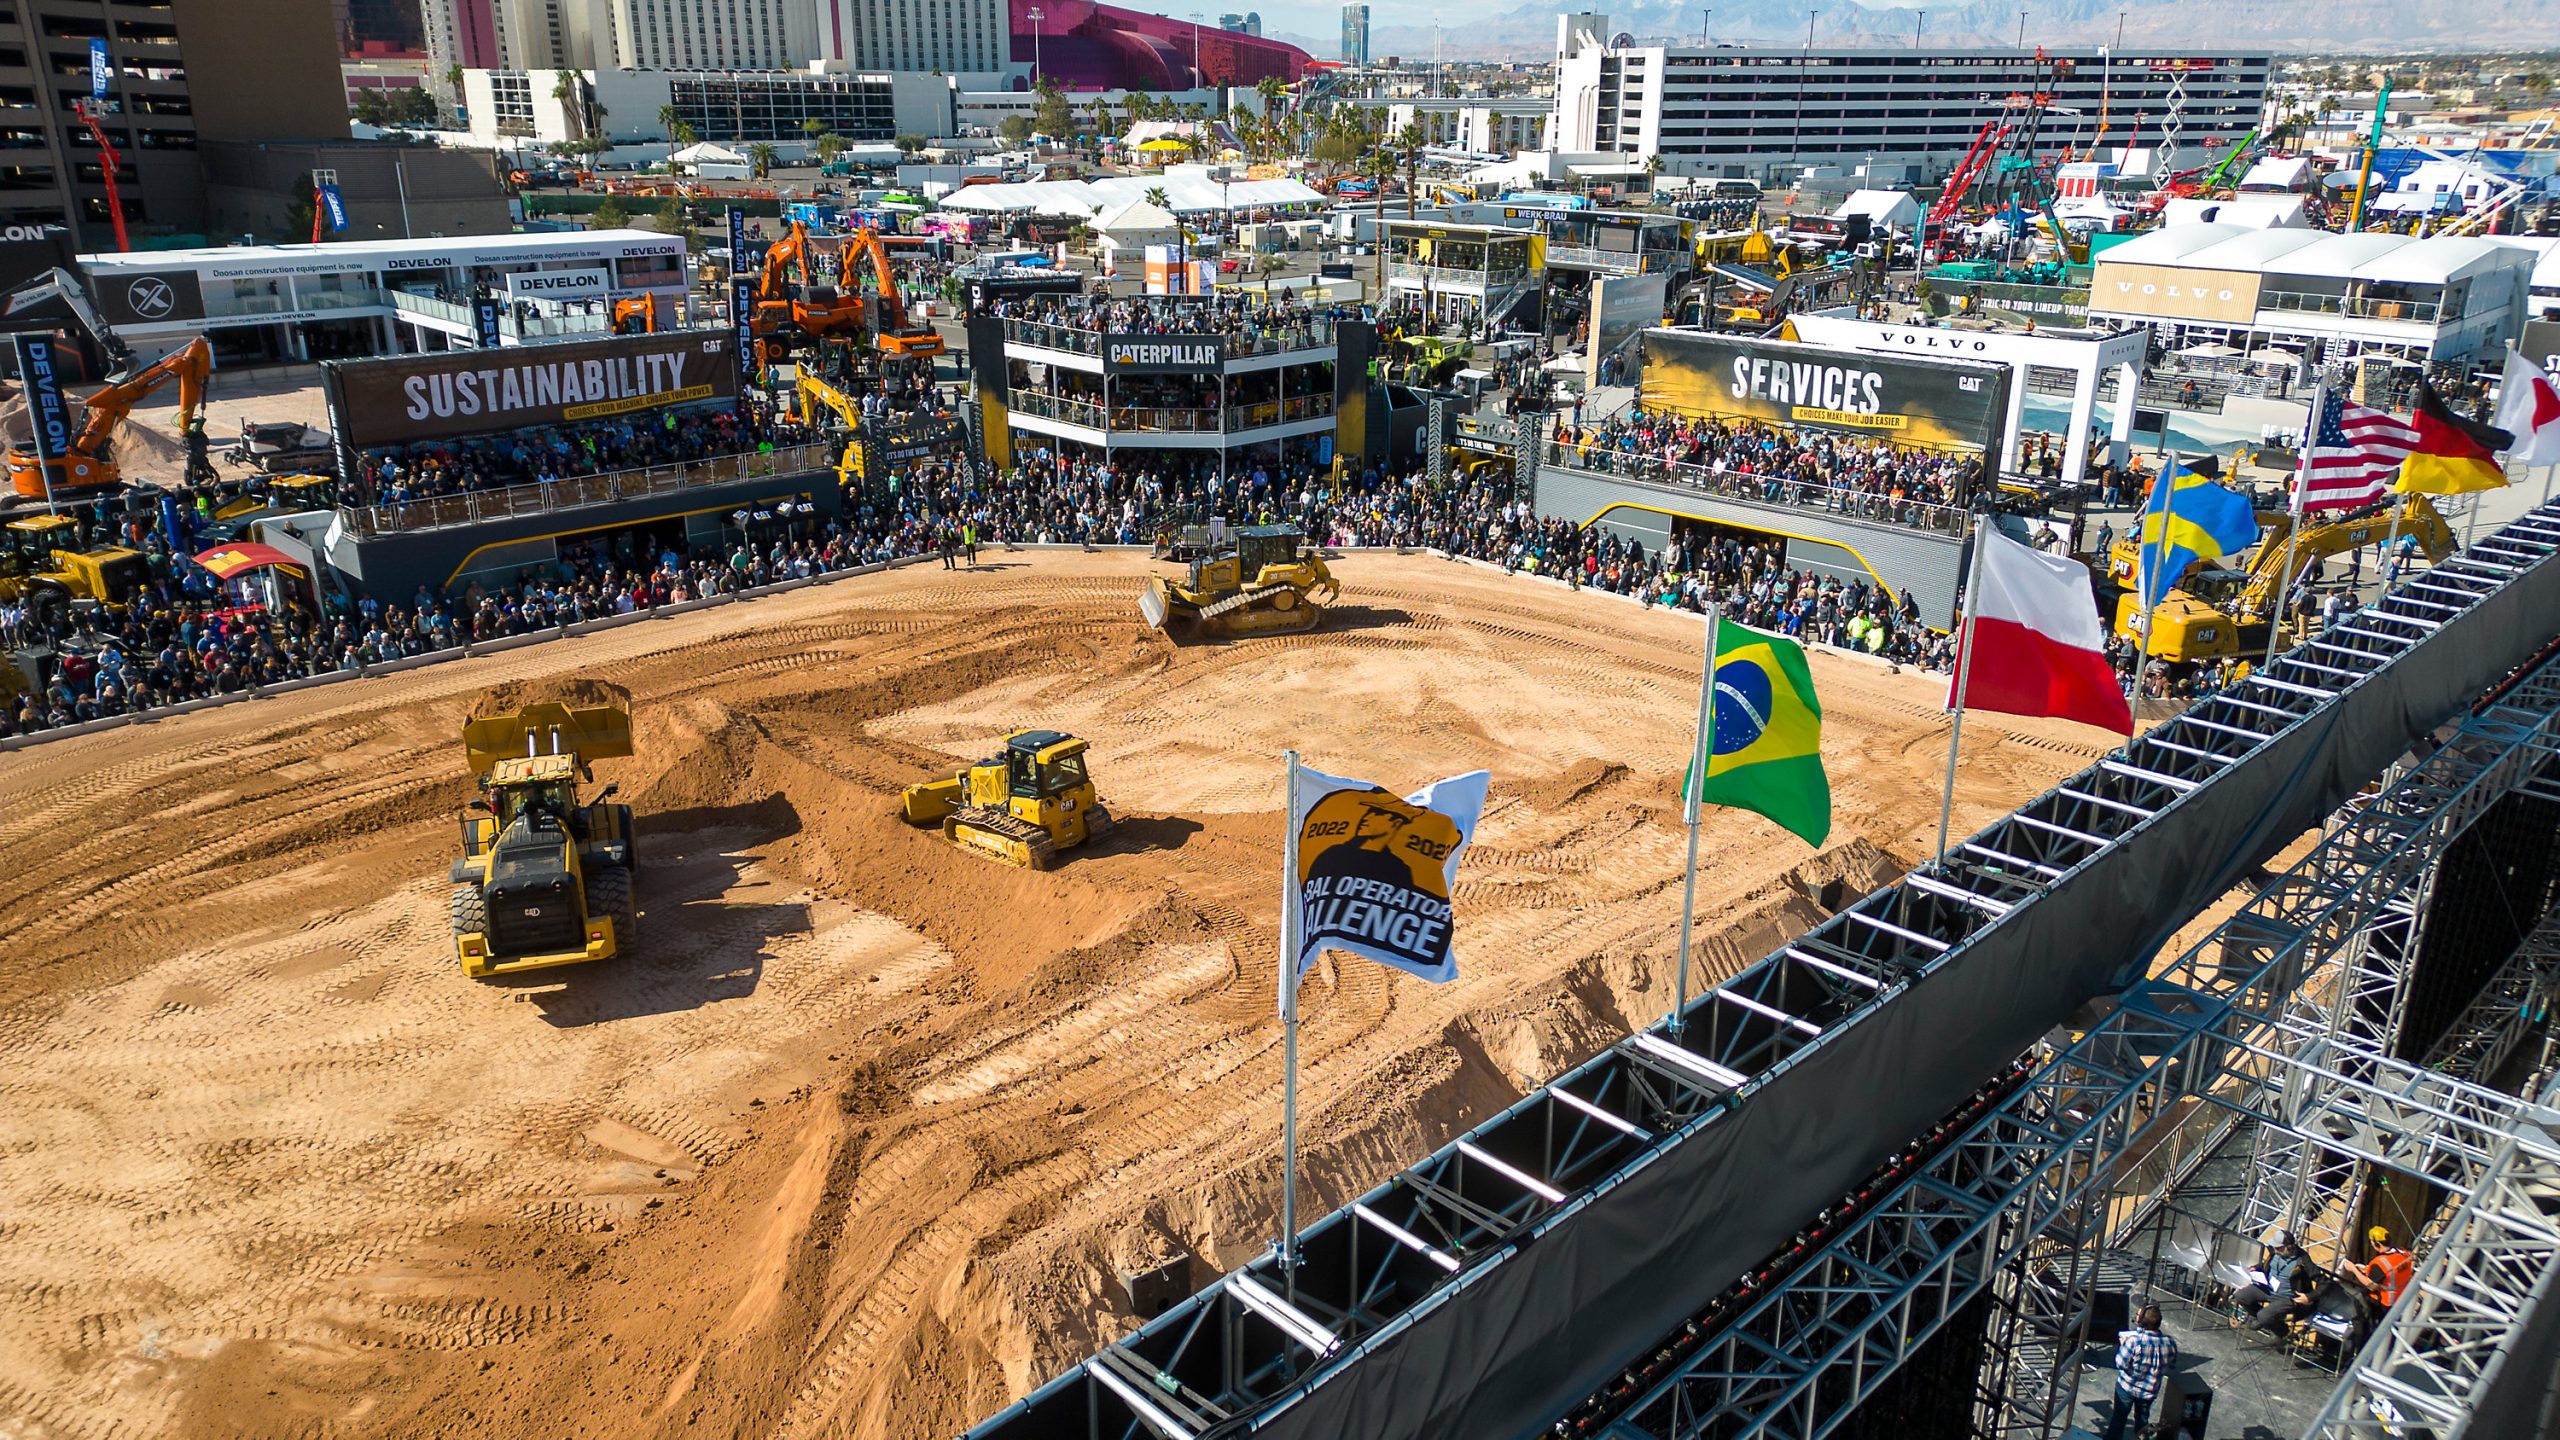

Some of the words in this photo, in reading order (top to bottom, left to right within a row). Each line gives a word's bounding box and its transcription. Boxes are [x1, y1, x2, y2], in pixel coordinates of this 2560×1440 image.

[733, 211, 746, 272] DEVELON
[475, 254, 500, 263] Doosan
[501, 252, 543, 262] construction
[545, 251, 579, 261] equipment
[622, 246, 675, 256] DEVELON
[213, 269, 243, 278] Doosan
[244, 266, 295, 276] construction
[296, 264, 338, 274] equipment
[347, 262, 363, 270] now
[388, 257, 451, 269] DEVELON
[520, 276, 599, 291] DEVELON
[2116, 281, 2233, 301] VOLVO
[2001, 299, 2010, 310] TO
[2011, 300, 2033, 312] YOUR
[2035, 302, 2062, 314] LINEUP
[2064, 304, 2089, 316] TODAY
[738, 286, 751, 373] DEVELON
[703, 339, 723, 353] CAT
[1881, 332, 1986, 351] VOLVO
[1111, 344, 1217, 365] CATERPILLAR
[404, 352, 686, 421] SUSTAINABILITY
[1732, 356, 1882, 414] SERVICES
[1959, 376, 1983, 392] CAT
[28, 342, 67, 454] DEVELON
[568, 407, 596, 417] CHOOSE
[598, 405, 616, 413] YOUR
[646, 395, 671, 405] CHOOSE
[672, 391, 688, 402] YOUR
[1799, 409, 1826, 419] CHOICES
[1827, 411, 1843, 421] MAKE
[1844, 413, 1859, 423] YOUR
[1860, 415, 1874, 425] JOB
[1875, 416, 1900, 426] EASIER
[753, 510, 772, 521] CAT
[797, 502, 815, 513] CAT
[2351, 530, 2367, 543] CAT
[2114, 558, 2130, 576] CAT
[2197, 629, 2216, 642] CAT
[1061, 798, 1075, 812] CAT
[1307, 821, 1350, 839] 2022
[1335, 876, 1451, 922] OPERATOR
[1304, 898, 1447, 959] ALLENGE
